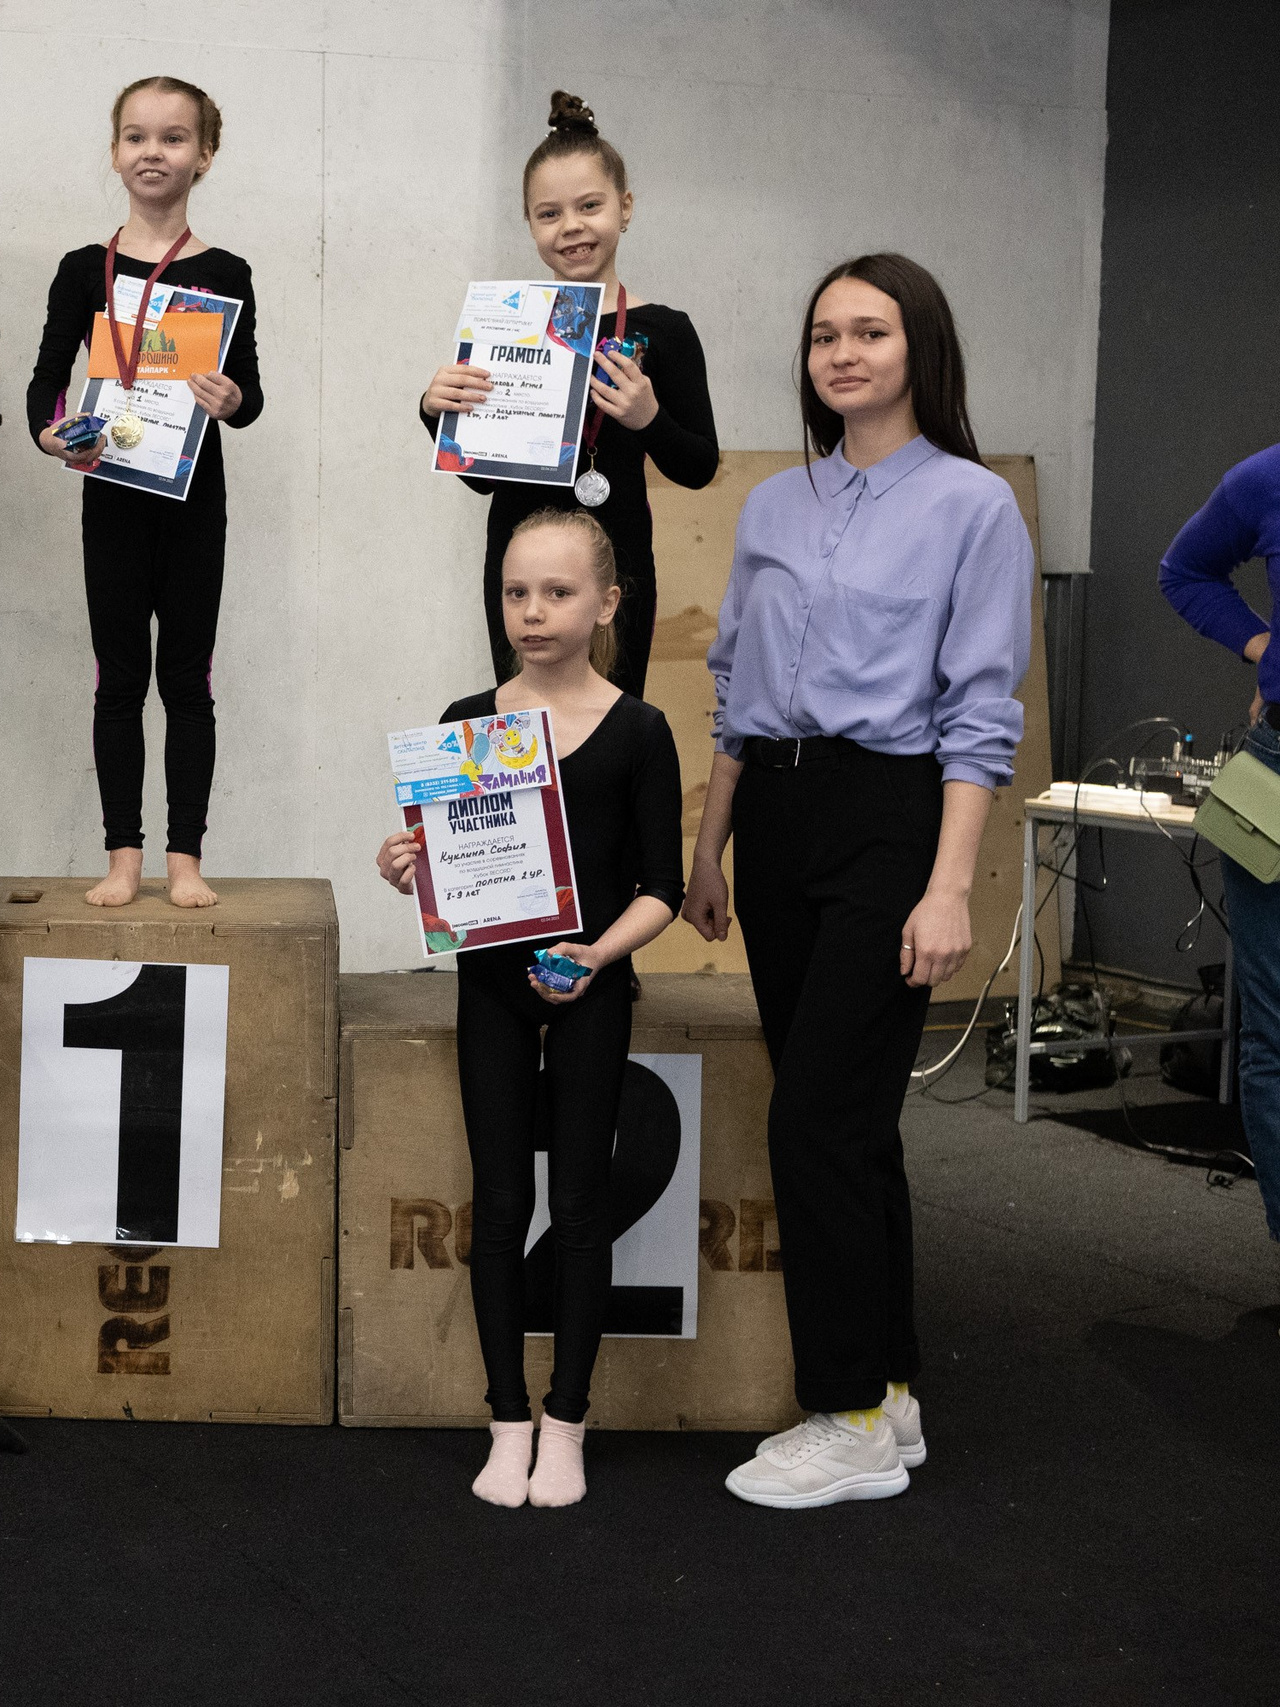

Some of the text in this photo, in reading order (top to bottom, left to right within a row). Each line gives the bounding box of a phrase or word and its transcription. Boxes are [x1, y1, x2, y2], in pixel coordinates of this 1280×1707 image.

[490, 346, 551, 365] ГРАМОТА
[448, 792, 513, 821] ДИПЛОМ
[449, 811, 517, 834] УЧАСТНИКА
[458, 835, 514, 850] НАГРАЖДАЕТСЯ
[483, 916, 501, 924] ARENA
[63, 964, 187, 1243] 1
